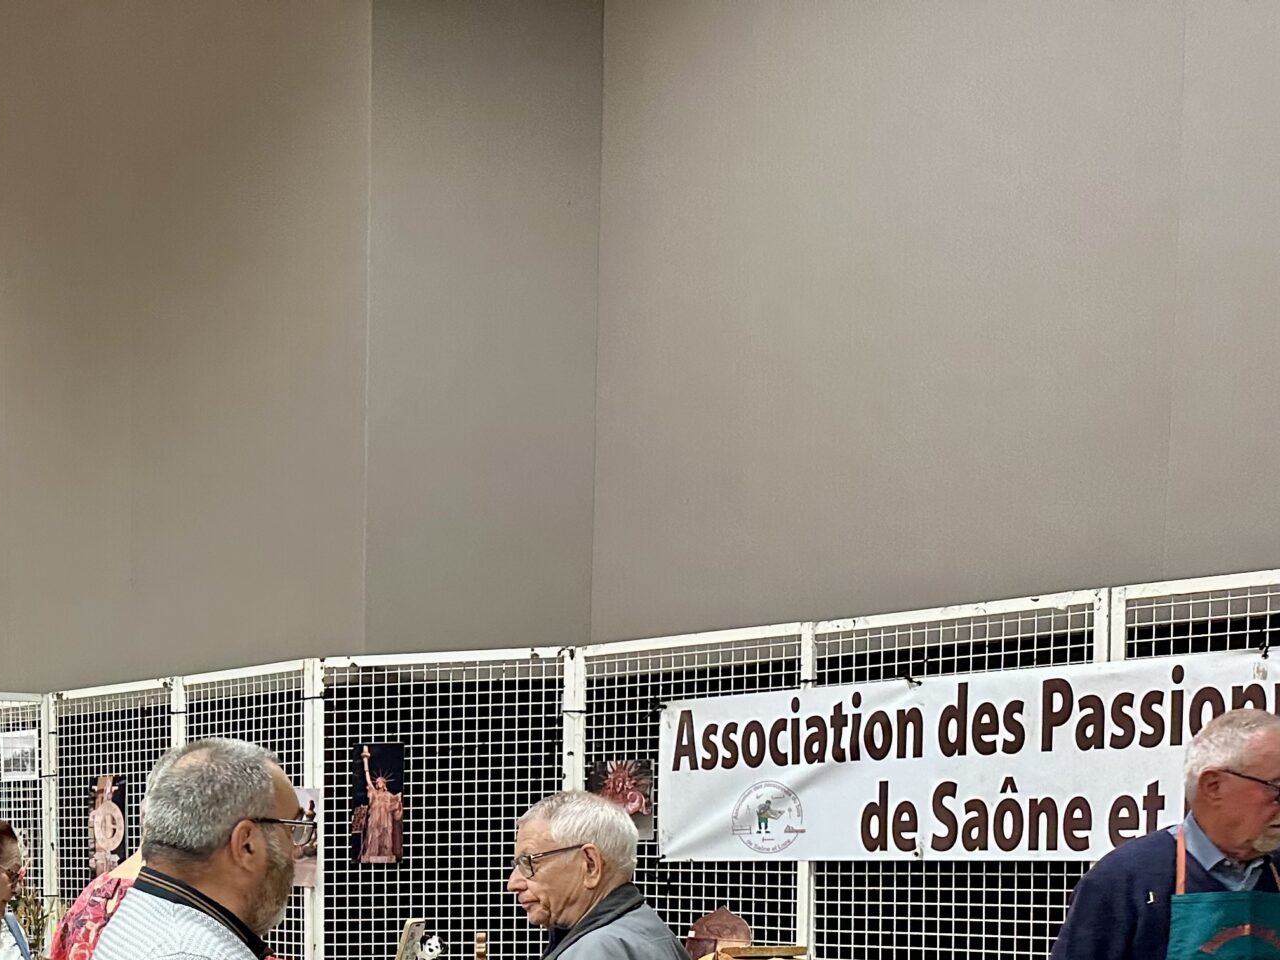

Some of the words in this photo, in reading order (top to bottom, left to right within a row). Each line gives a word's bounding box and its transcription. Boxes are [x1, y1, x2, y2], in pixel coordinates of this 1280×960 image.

[672, 692, 923, 771] Association
[938, 682, 1025, 757] des
[1041, 664, 1280, 751] Passion
[860, 780, 918, 852] de
[930, 776, 1092, 852] Saône
[1108, 779, 1165, 849] et
